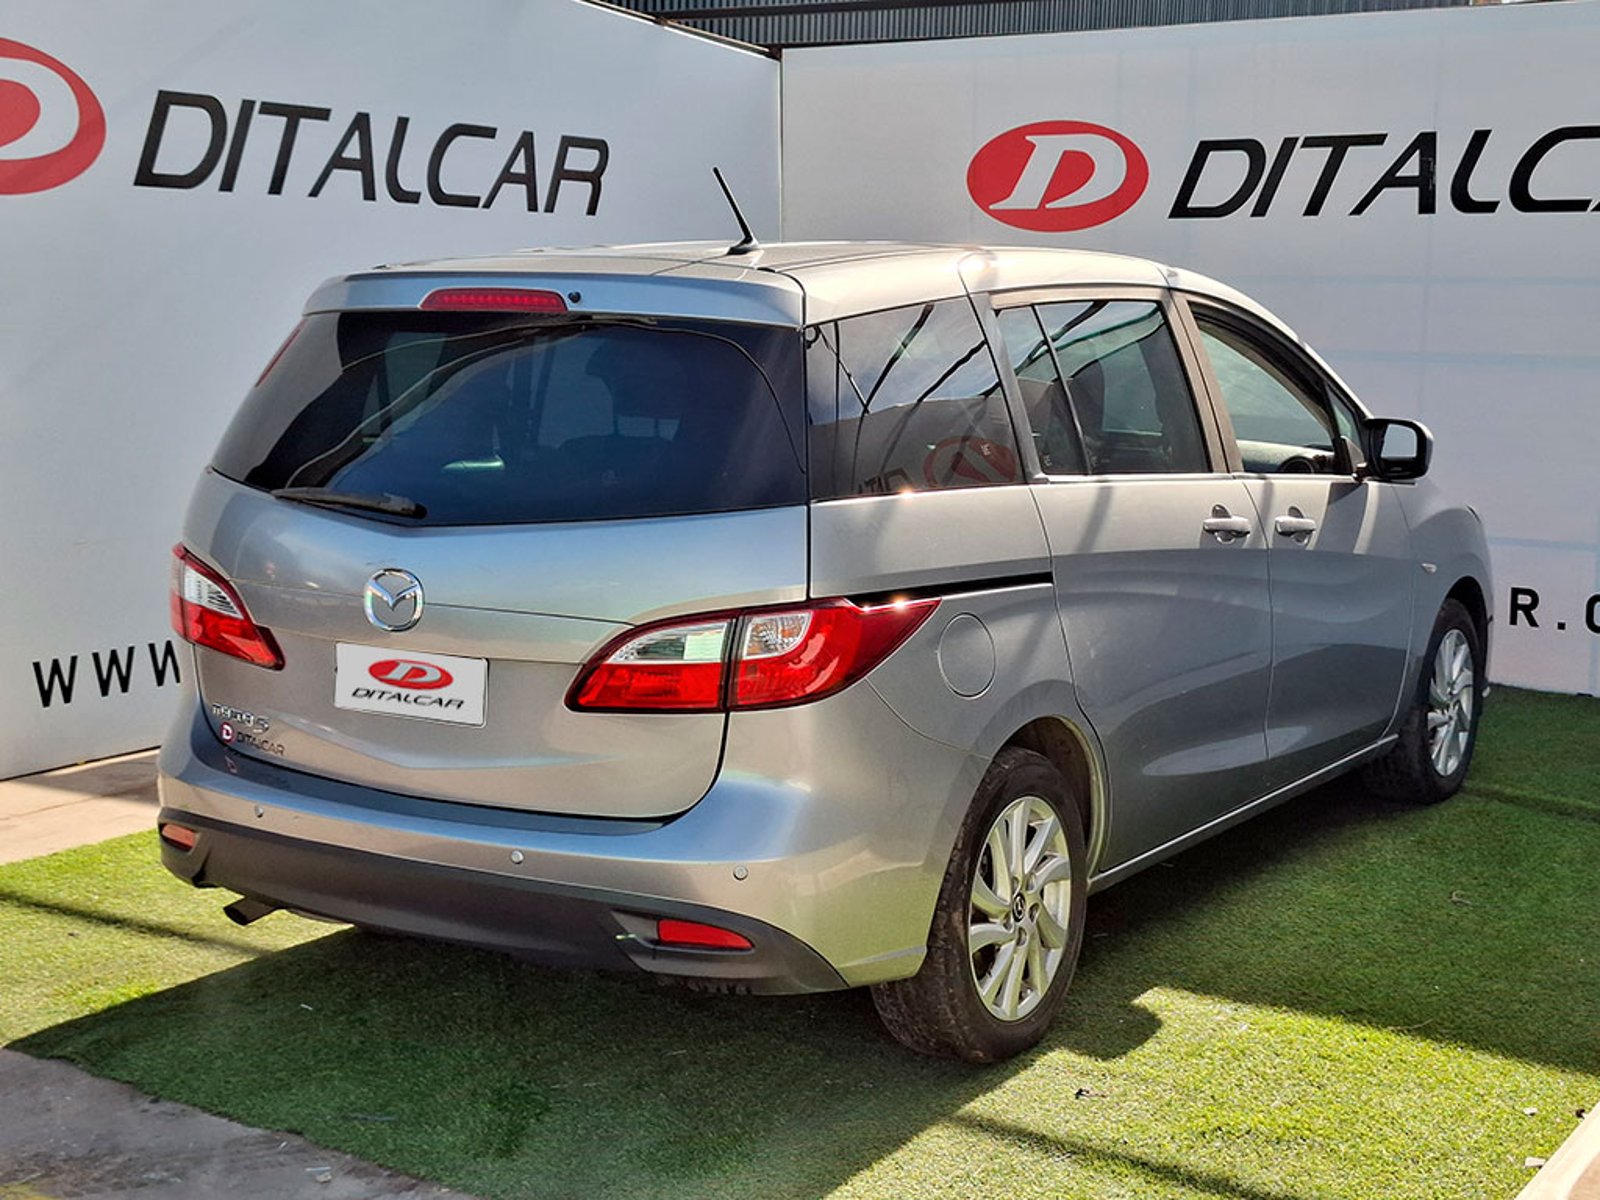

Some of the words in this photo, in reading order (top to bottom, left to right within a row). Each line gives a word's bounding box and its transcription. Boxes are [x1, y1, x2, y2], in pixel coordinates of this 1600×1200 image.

[133, 89, 610, 217] DITALCAR
[989, 132, 1128, 211] D
[1167, 126, 1600, 219] DITALC
[351, 687, 465, 710] DITALCAR
[237, 731, 285, 756] DITALCAR
